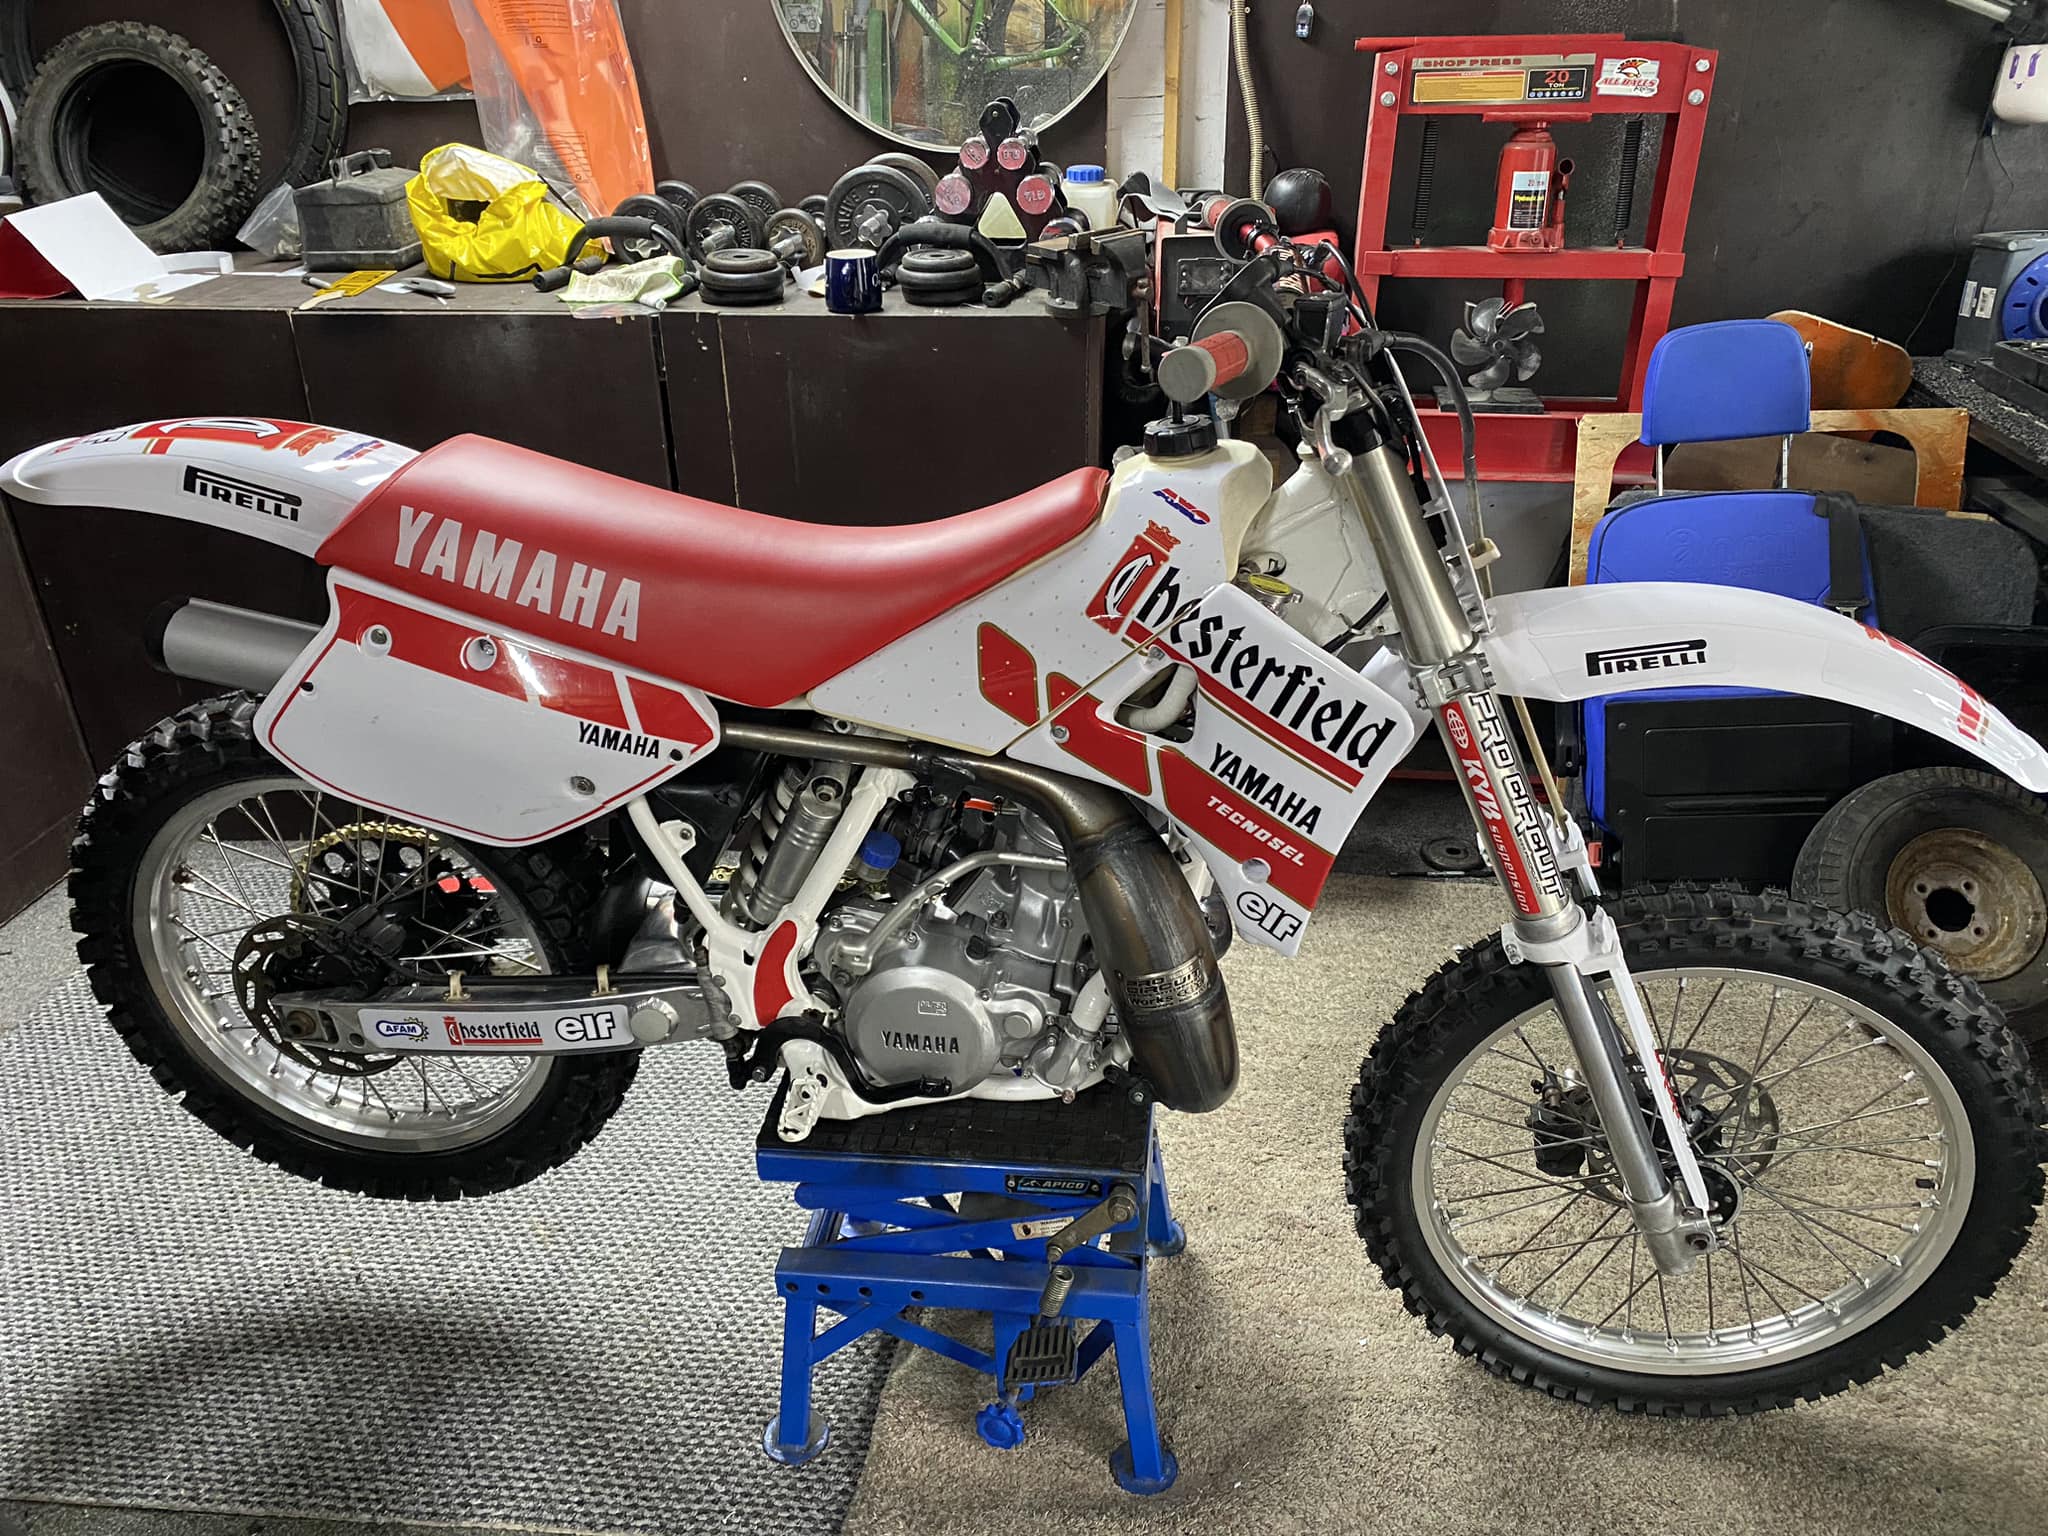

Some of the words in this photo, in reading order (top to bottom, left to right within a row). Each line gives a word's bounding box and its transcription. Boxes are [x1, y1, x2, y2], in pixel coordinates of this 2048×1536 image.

[1469, 58, 1522, 66] PRESS
[1544, 70, 1570, 83] 20
[183, 465, 302, 521] PIRELLI
[394, 505, 641, 641] YAMAHA
[1104, 553, 1398, 768] Chesterfield
[1585, 639, 1707, 676] PIRELLI
[578, 721, 660, 759] YAMAHA
[1209, 742, 1322, 835] YAMAHA
[1471, 692, 1515, 769] PRO
[1503, 773, 1565, 899] CIRCUIT
[1206, 795, 1305, 867] TECNOSEL
[1462, 758, 1502, 821] KYB
[1488, 824, 1530, 913] suspension
[1237, 891, 1303, 942] elf
[385, 1023, 417, 1034] AFAM
[446, 1020, 542, 1045] Chesterfield
[555, 1011, 616, 1042] elf
[881, 1030, 960, 1054] YAMAHA
[1042, 1180, 1085, 1190] APICO
